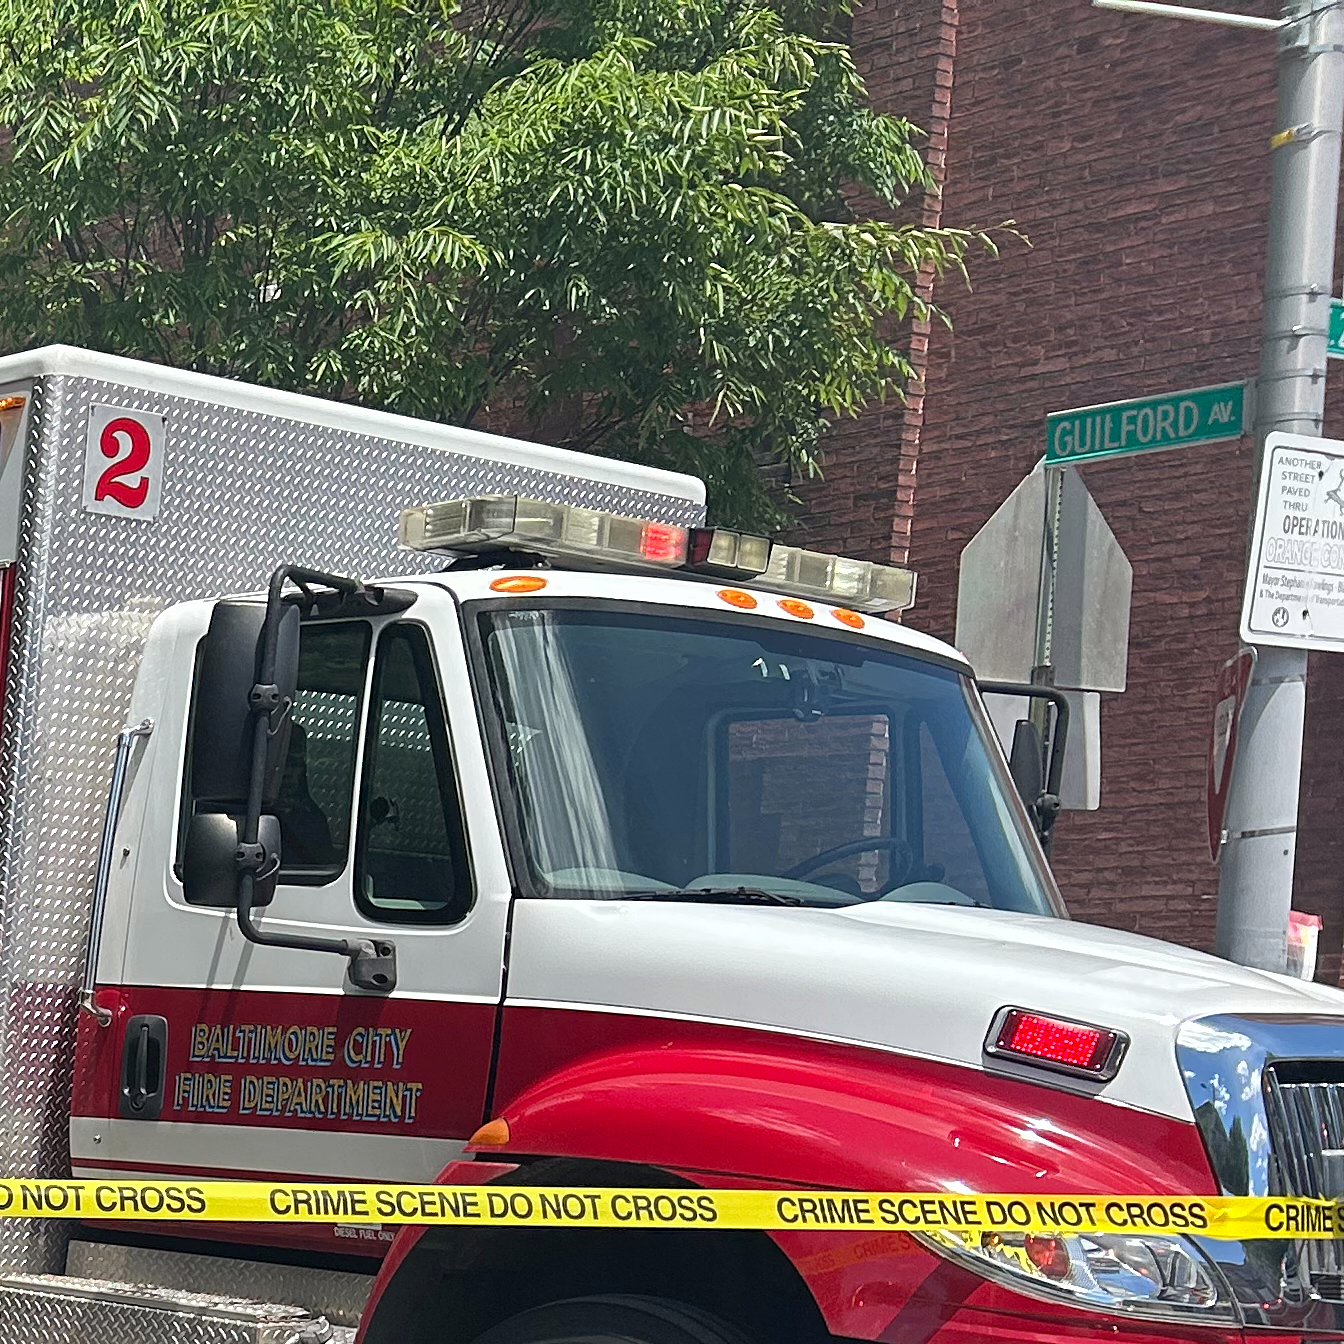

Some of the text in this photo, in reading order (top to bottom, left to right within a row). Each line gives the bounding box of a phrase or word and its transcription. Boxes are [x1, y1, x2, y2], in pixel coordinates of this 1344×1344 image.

[1054, 399, 1236, 456] GUILFORD AV.
[95, 417, 150, 509] 2
[1278, 456, 1322, 470] ANOTHER
[1281, 470, 1316, 484] STREET
[1281, 485, 1311, 498] PAVED
[1283, 500, 1308, 512] THRU
[1265, 536, 1320, 567] ORANGE
[189, 1022, 412, 1069] BALTIMORE CITY
[173, 1072, 423, 1123] FIRE DEPARTMENT
[21, 1184, 86, 1212] NOT
[95, 1185, 207, 1214] CROSS
[268, 1188, 718, 1223] CRIME SCENE DO NOT CROSS
[776, 1197, 1208, 1229] CRIME SCENE DO NOT CROSS
[1264, 1203, 1334, 1232] CRIME
[334, 1226, 396, 1242] DIESEL FUEL ONLY
